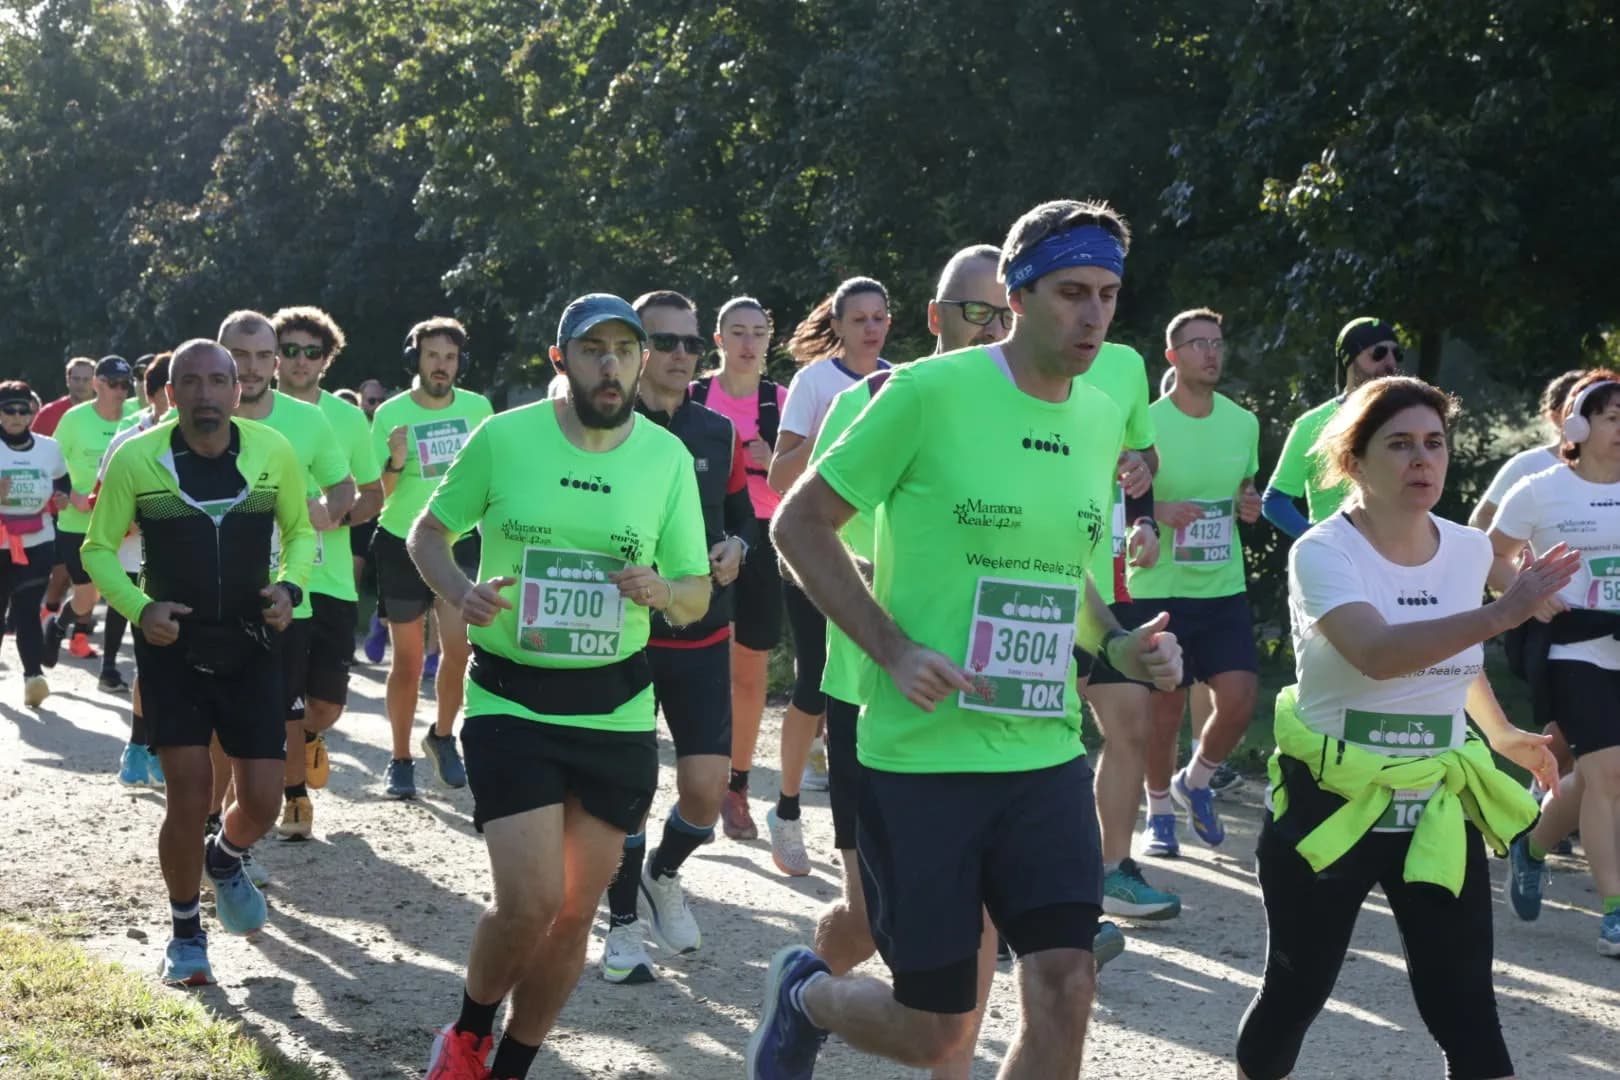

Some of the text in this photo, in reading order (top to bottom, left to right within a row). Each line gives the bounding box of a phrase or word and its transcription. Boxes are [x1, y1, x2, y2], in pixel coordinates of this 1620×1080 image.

[966, 498, 1022, 515] Maratona
[1190, 522, 1221, 539] 4132
[966, 552, 1030, 570] Weekend
[1033, 559, 1064, 575] Reale
[1204, 547, 1229, 561] 10K
[543, 587, 604, 618] 5700
[1002, 591, 1061, 620] diadora
[569, 632, 616, 655] 10K
[995, 628, 1058, 667] 3604
[1022, 683, 1063, 709] 10K
[1368, 719, 1435, 746] diadora
